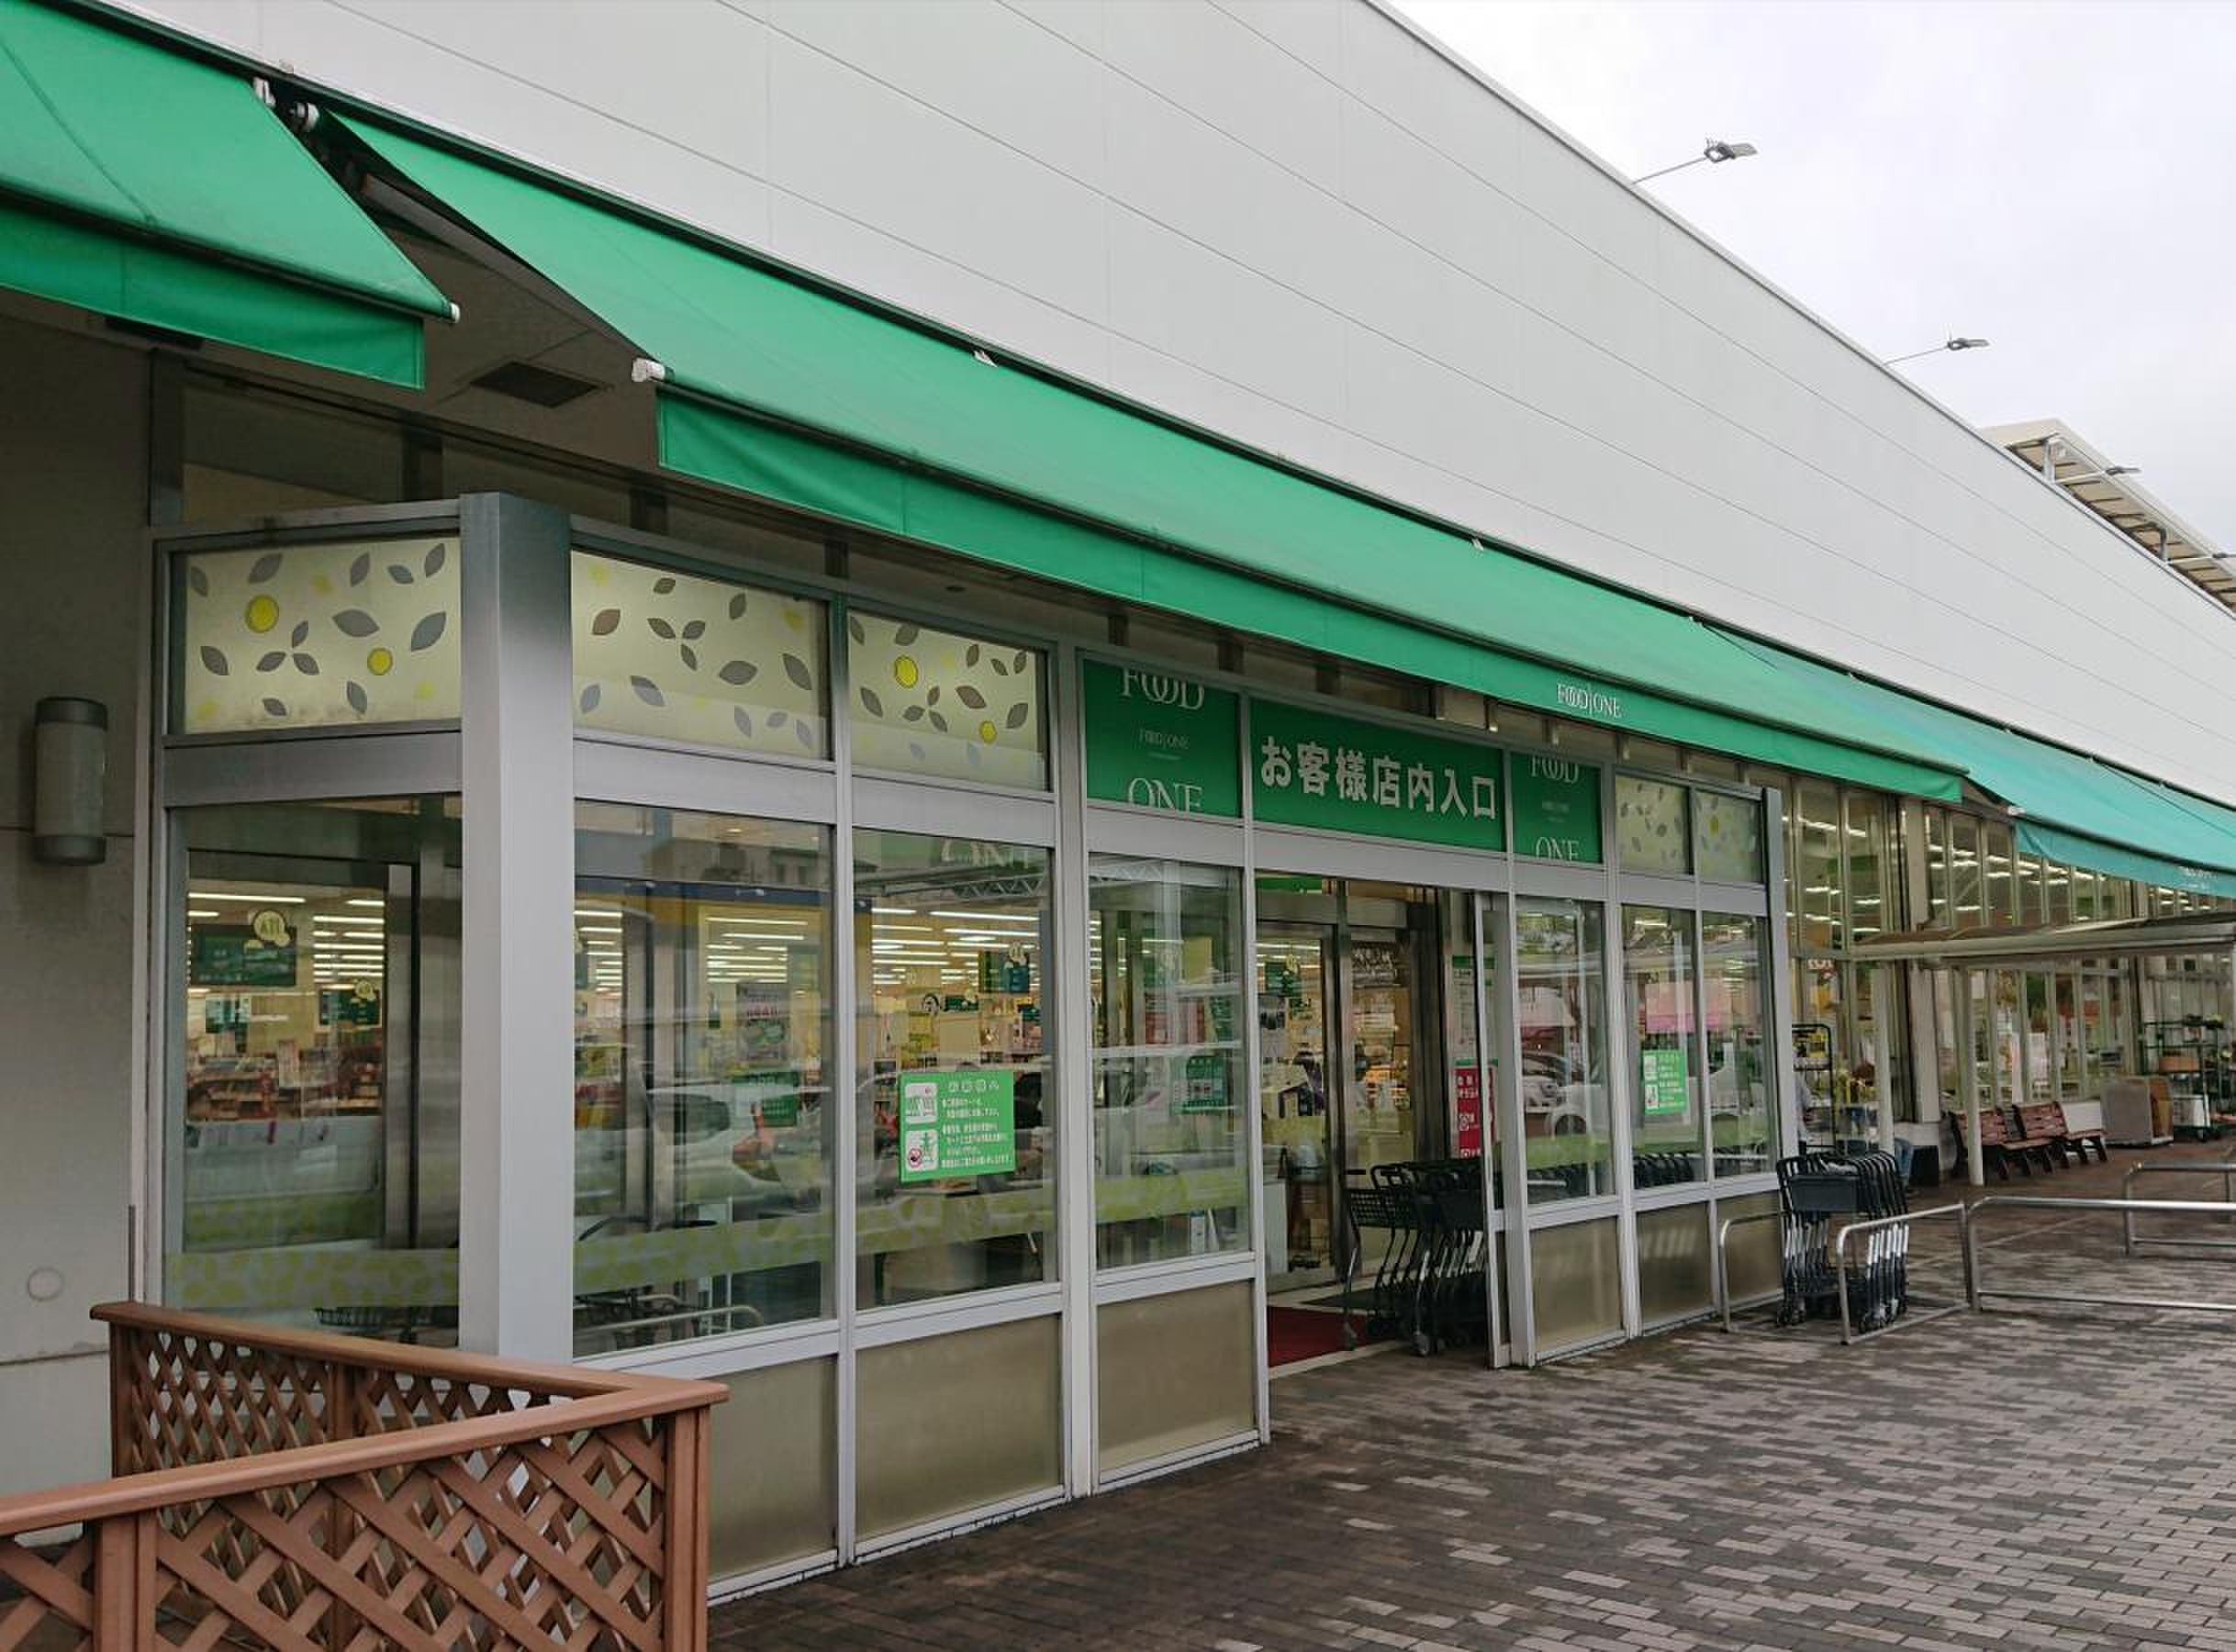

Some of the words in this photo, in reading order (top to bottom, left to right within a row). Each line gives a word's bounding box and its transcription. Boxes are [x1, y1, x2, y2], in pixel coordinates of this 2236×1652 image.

[1121, 669, 1205, 710] FOOD
[1128, 777, 1203, 811] ONE
[1260, 735, 1496, 820] お客様店内入口
